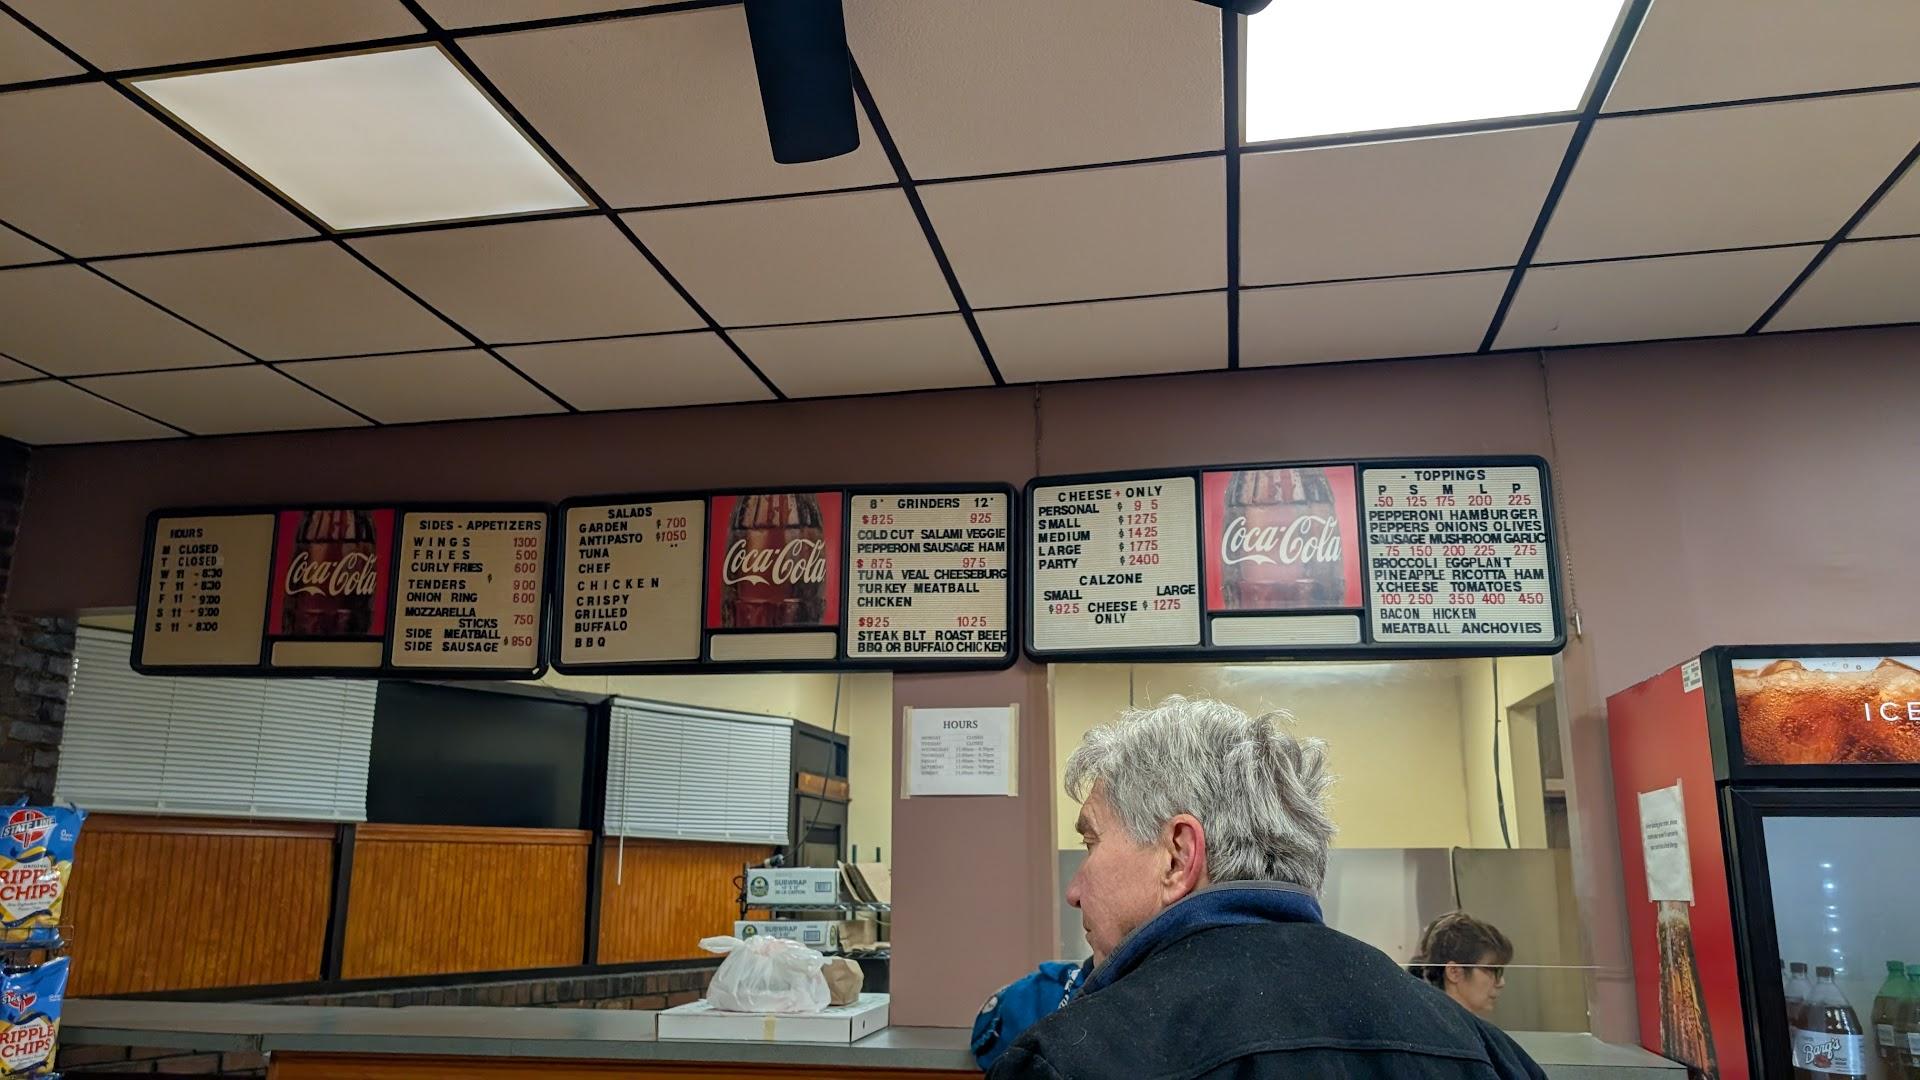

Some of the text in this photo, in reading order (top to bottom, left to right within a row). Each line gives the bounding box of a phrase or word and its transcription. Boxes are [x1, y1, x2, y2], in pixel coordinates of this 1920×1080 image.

[1415, 470, 1485, 481] TOPPINGS
[1058, 486, 1162, 502] CHEESE ONLY
[1379, 483, 1520, 495] P S M L P
[898, 498, 960, 508] GRINDERS
[1406, 496, 1427, 507] 125
[1436, 496, 1455, 506] 175
[1468, 495, 1492, 506] 200
[1508, 495, 1531, 505] 225
[608, 507, 652, 519] SALADS
[1039, 504, 1099, 516] PERSONAL
[1369, 509, 1537, 521] PEPPERONI HAMBURGER
[970, 513, 991, 523] 925
[1039, 518, 1080, 529] SMALL
[420, 521, 541, 530] SIDES APPETIZERS
[579, 522, 628, 533] GARDEN
[1370, 521, 1542, 532] PEPPERS ONIONS OLIVES
[170, 528, 203, 538] HOURS
[858, 529, 1005, 540] COLD CUT SALAMI VEGGIE
[1039, 531, 1090, 542] MEDIUM
[1370, 533, 1547, 544] SAUSAGE MUSHROOM GARLIC
[513, 538, 537, 547] 1300
[579, 534, 642, 546] ANTIPASTO
[1222, 515, 1341, 564] Coca-Cola
[179, 544, 218, 554] CLOSED
[858, 542, 1005, 553] PEPPERONI SAUSAGE HAM
[1039, 545, 1081, 556] LARGE
[1410, 546, 1432, 556] 150
[1443, 546, 1465, 556] 200
[1474, 545, 1495, 555] 225
[1514, 545, 1537, 555] 275
[516, 551, 537, 560] 500
[579, 549, 609, 559] TUNA
[162, 557, 216, 567] T CLOSED
[723, 539, 826, 585] Coca-Cola
[963, 558, 985, 568] 975
[1039, 559, 1078, 569] PARTY
[1373, 558, 1512, 568] BROCCOLI EGGPLANT
[411, 563, 535, 573] CURLY FRIES 600
[579, 563, 610, 573] CHEF
[161, 570, 169, 578] W
[285, 552, 376, 596] Coca-Cola
[858, 570, 893, 580] TUNA
[902, 570, 929, 579] VEAL
[1080, 573, 1142, 585] CALZONE
[1375, 569, 1544, 580] PINEAPPLE RICOTTA HAM
[160, 582, 165, 591] T
[409, 580, 535, 590] TENDERS 900
[578, 578, 659, 591] CHICKEN
[858, 583, 979, 593] TURKEY MEATBALL
[1450, 582, 1521, 592] TOMATOES
[407, 593, 535, 603] ONION RING 600
[1044, 585, 1196, 601] SMALL LARGE
[1381, 593, 1543, 604] 100 250 350 400 450
[159, 595, 165, 604] F
[577, 595, 629, 606] CRISPY
[858, 597, 912, 607] CHICKEN
[405, 607, 476, 617] MOZZARELLA
[1088, 601, 1137, 612] CHEESE
[157, 609, 163, 618] S
[575, 608, 627, 619] GRILLED
[1095, 613, 1126, 624] ONLY
[1381, 608, 1419, 619] BACON
[459, 615, 533, 628] STICKS 750
[575, 621, 627, 632] BUFFALO
[957, 616, 987, 627] 1025
[155, 623, 161, 632] S
[1382, 622, 1542, 634] MEATBALL ANCHOVIES
[406, 629, 500, 639] SIDE MEATBALL
[858, 631, 1007, 641] STEAK BLT ROAST BEEF
[405, 642, 498, 652] SIDE SAUSAGE
[858, 642, 1007, 652] BBQ OR BUFFALO CHICKEN
[1864, 702, 1920, 721] ICE
[2, 817, 56, 837] STATE LINE
[0, 883, 57, 900] CHIPS
[0, 1024, 55, 1044] RIPPLE
[2, 1039, 50, 1058] CHIPS
